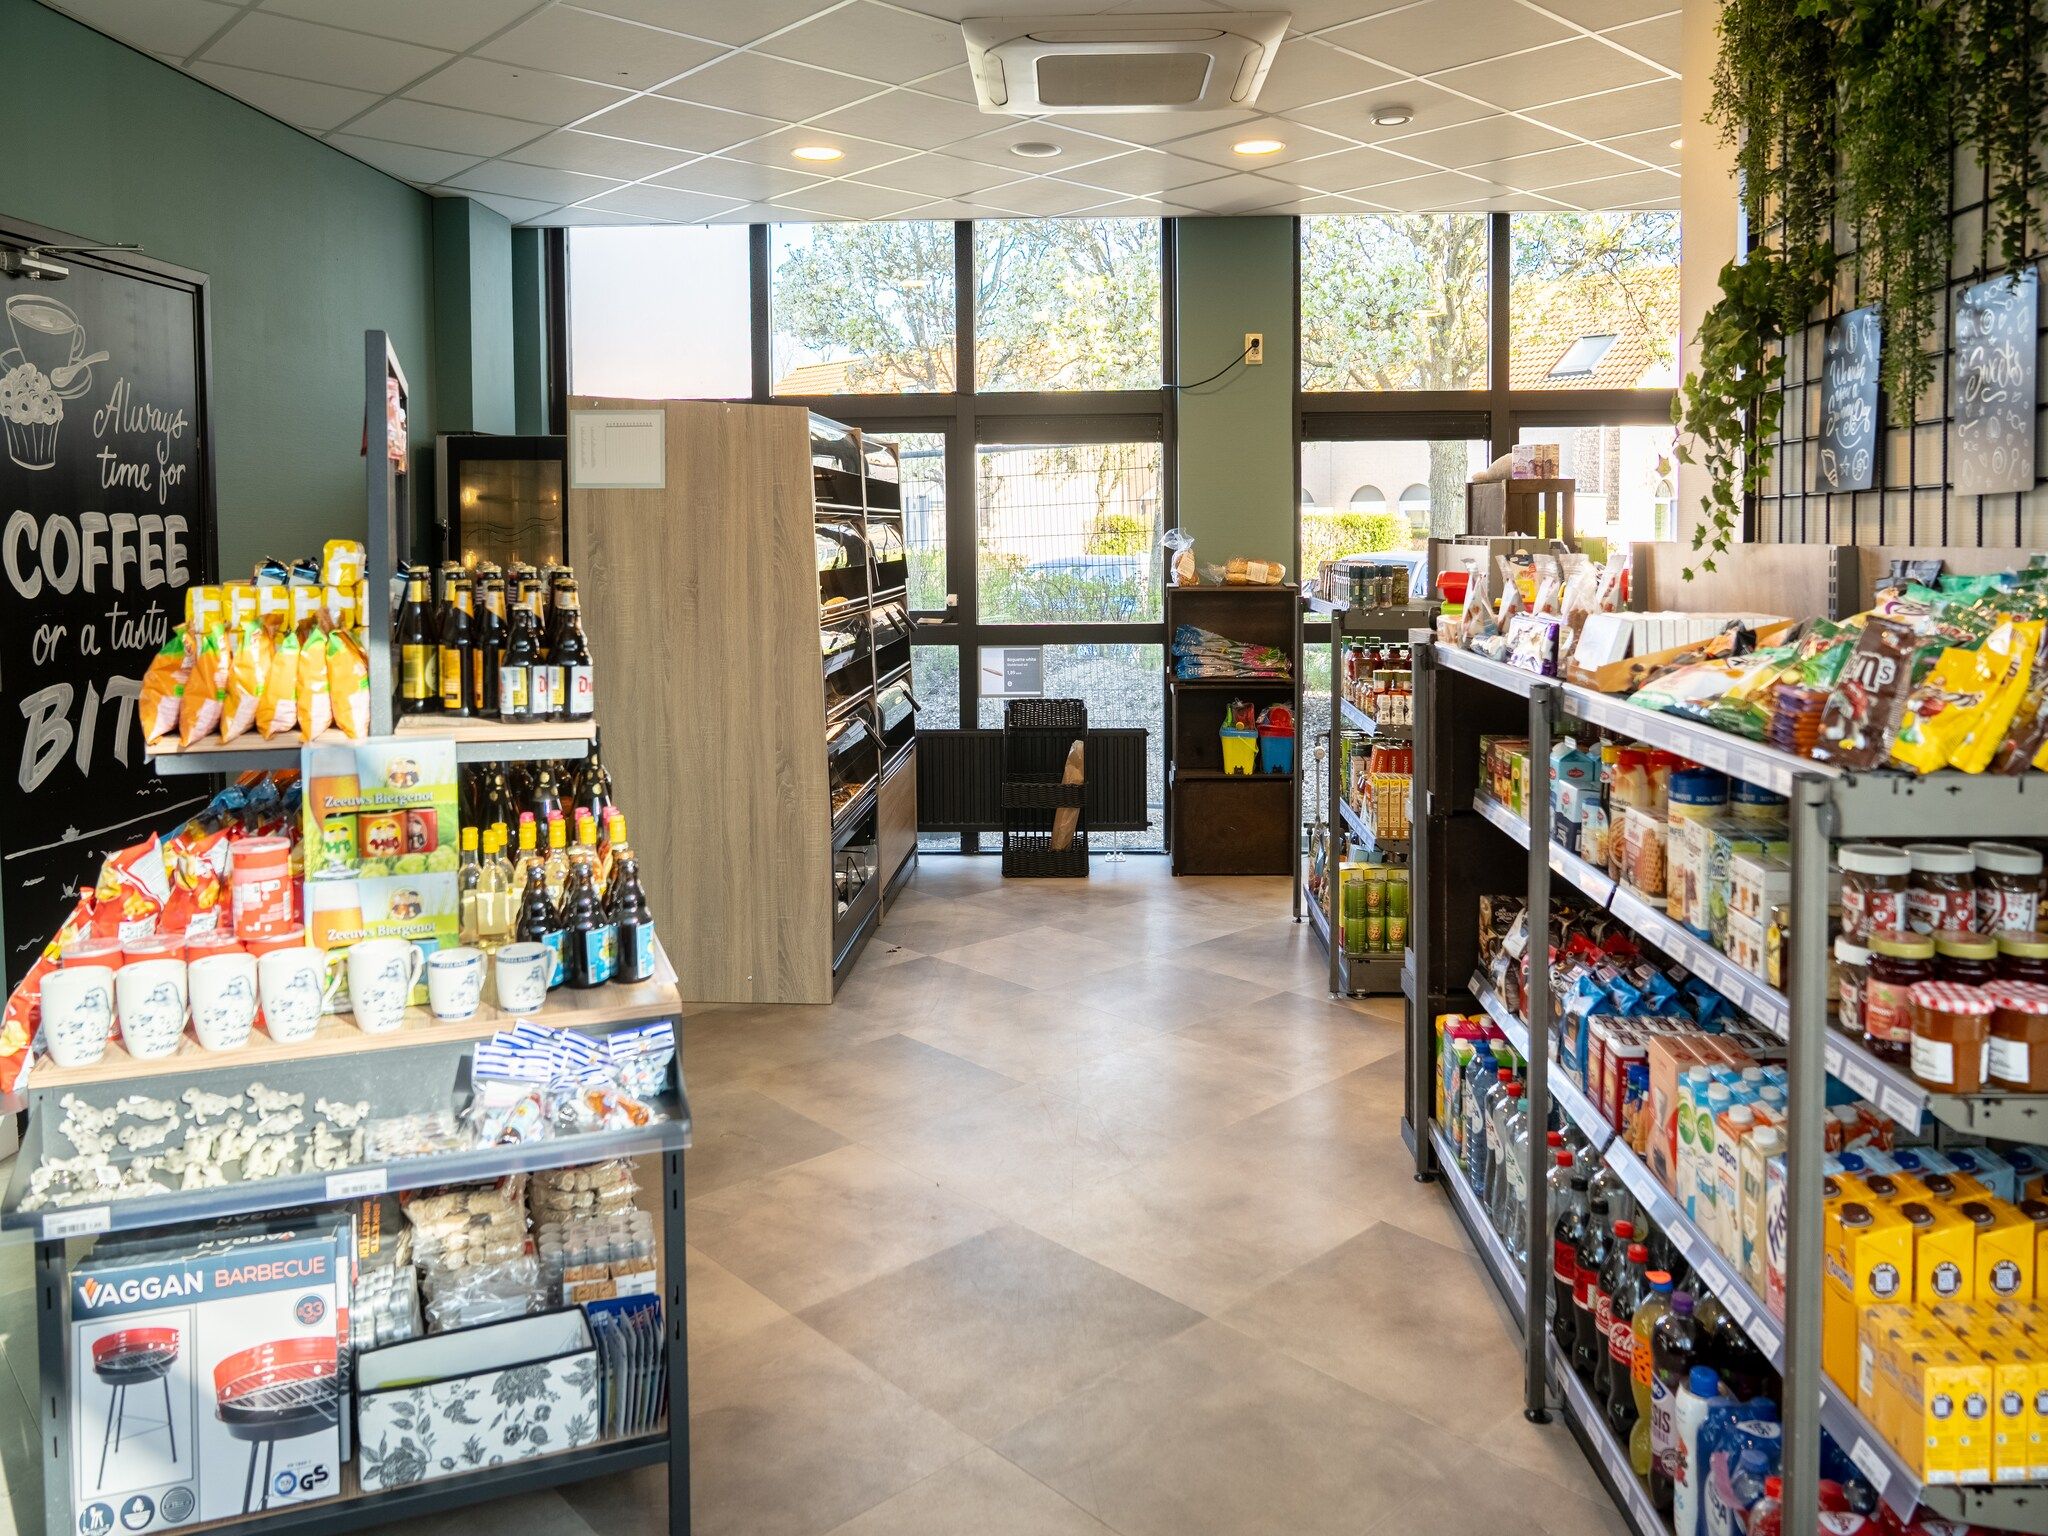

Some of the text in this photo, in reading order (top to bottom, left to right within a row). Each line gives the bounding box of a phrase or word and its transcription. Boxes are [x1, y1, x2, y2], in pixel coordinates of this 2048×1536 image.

[1965, 341, 2024, 402] Sweets
[94, 377, 188, 464] Always
[97, 445, 186, 506] time for
[3, 510, 190, 599] COFFEE
[33, 600, 167, 666] or a tasty
[18, 674, 142, 793] BIT
[374, 790, 434, 808] Biergenot
[376, 921, 436, 938] Biergenot
[80, 1256, 326, 1309] VAGGAN BARBECUE
[1652, 1405, 1671, 1433] SIS
[300, 1465, 329, 1490] GS
